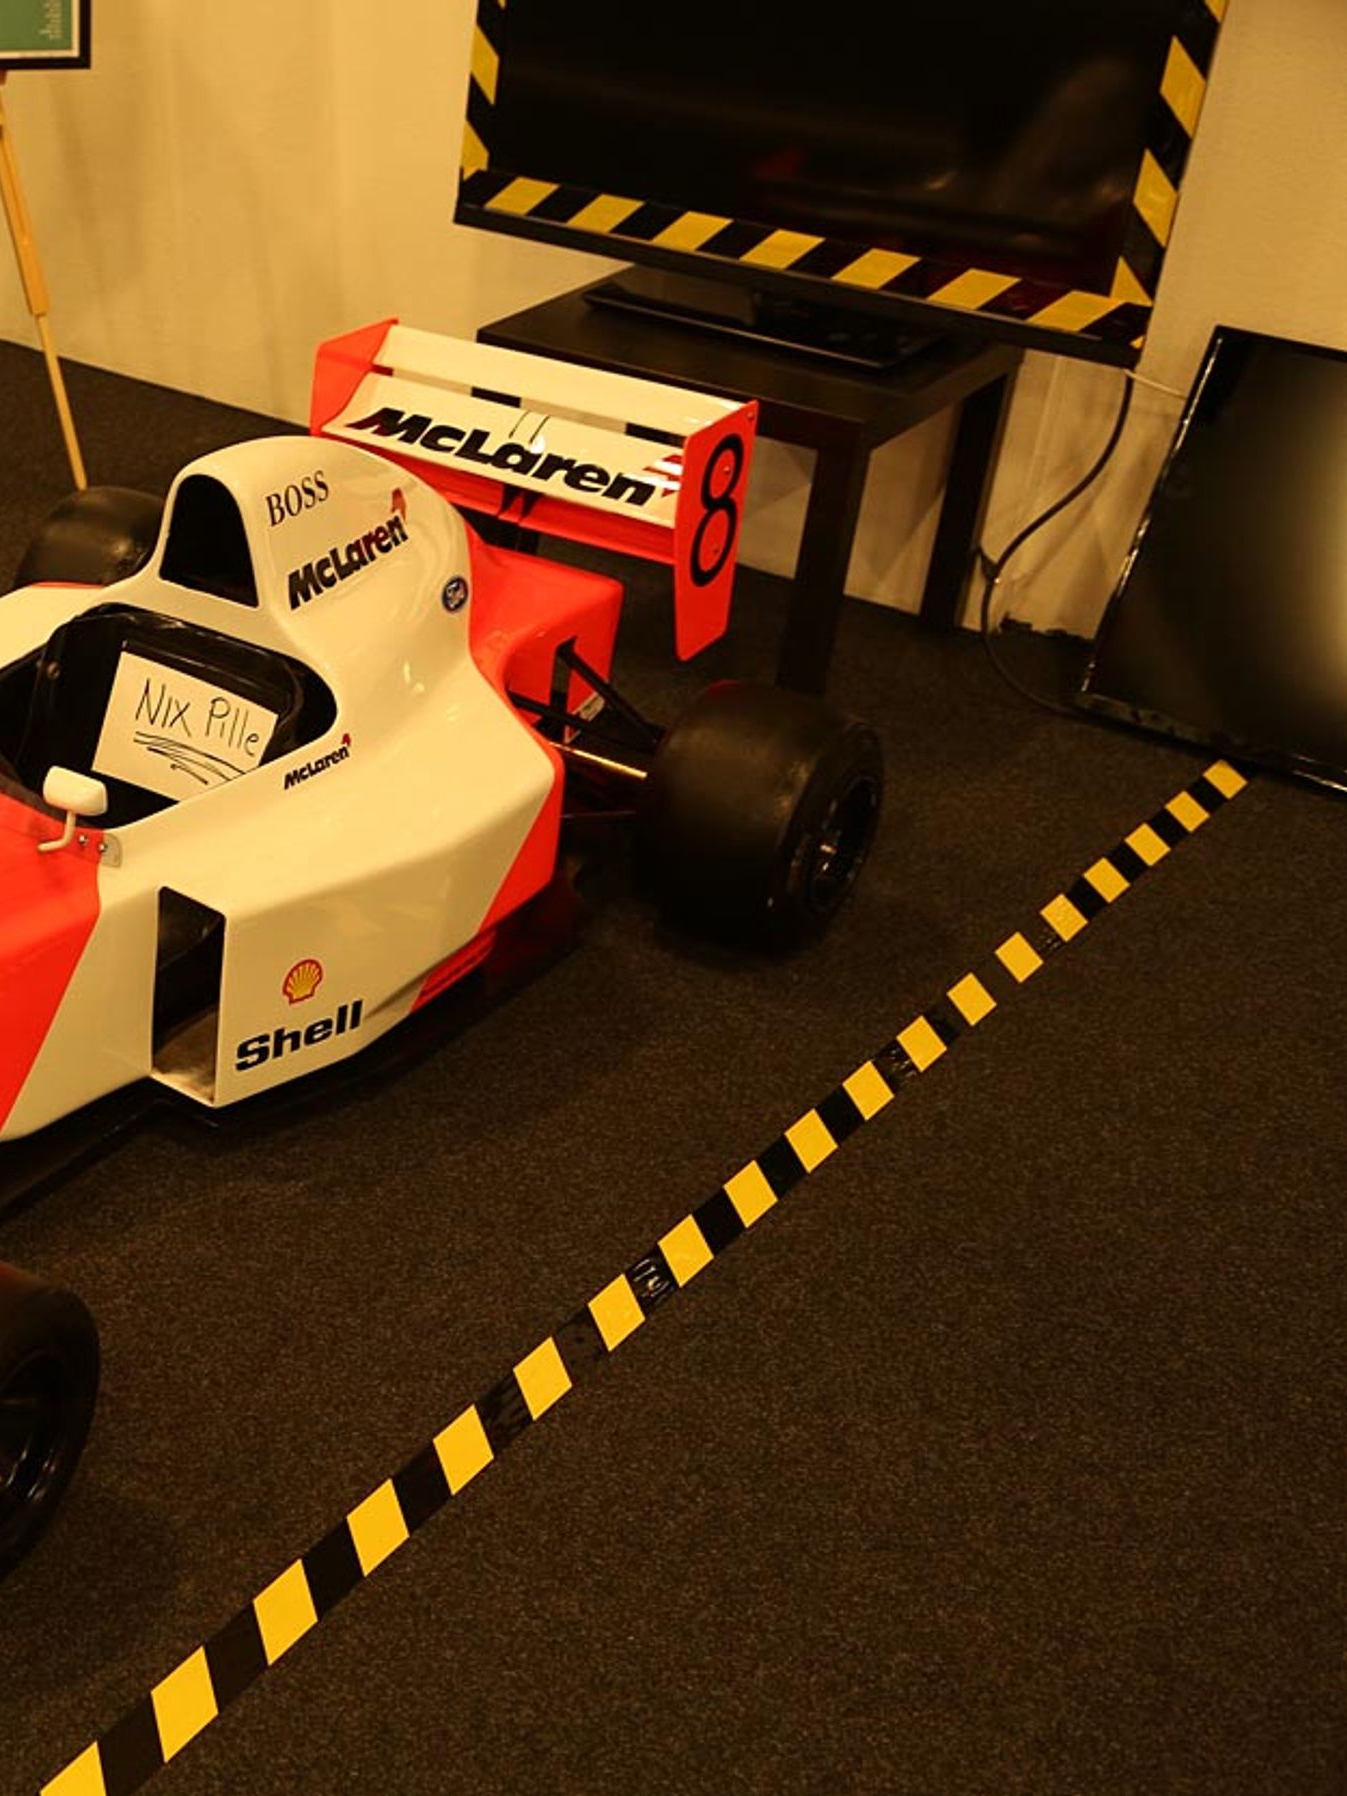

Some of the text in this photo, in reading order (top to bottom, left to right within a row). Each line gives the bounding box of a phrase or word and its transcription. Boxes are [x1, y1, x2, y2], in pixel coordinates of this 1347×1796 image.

[345, 407, 657, 507] McLaren
[265, 470, 329, 527] BOSS
[689, 433, 745, 588] 8
[287, 515, 409, 611] McLaren
[205, 696, 260, 758] Pille
[283, 746, 351, 790] McLaren
[235, 999, 364, 1071] Shell
